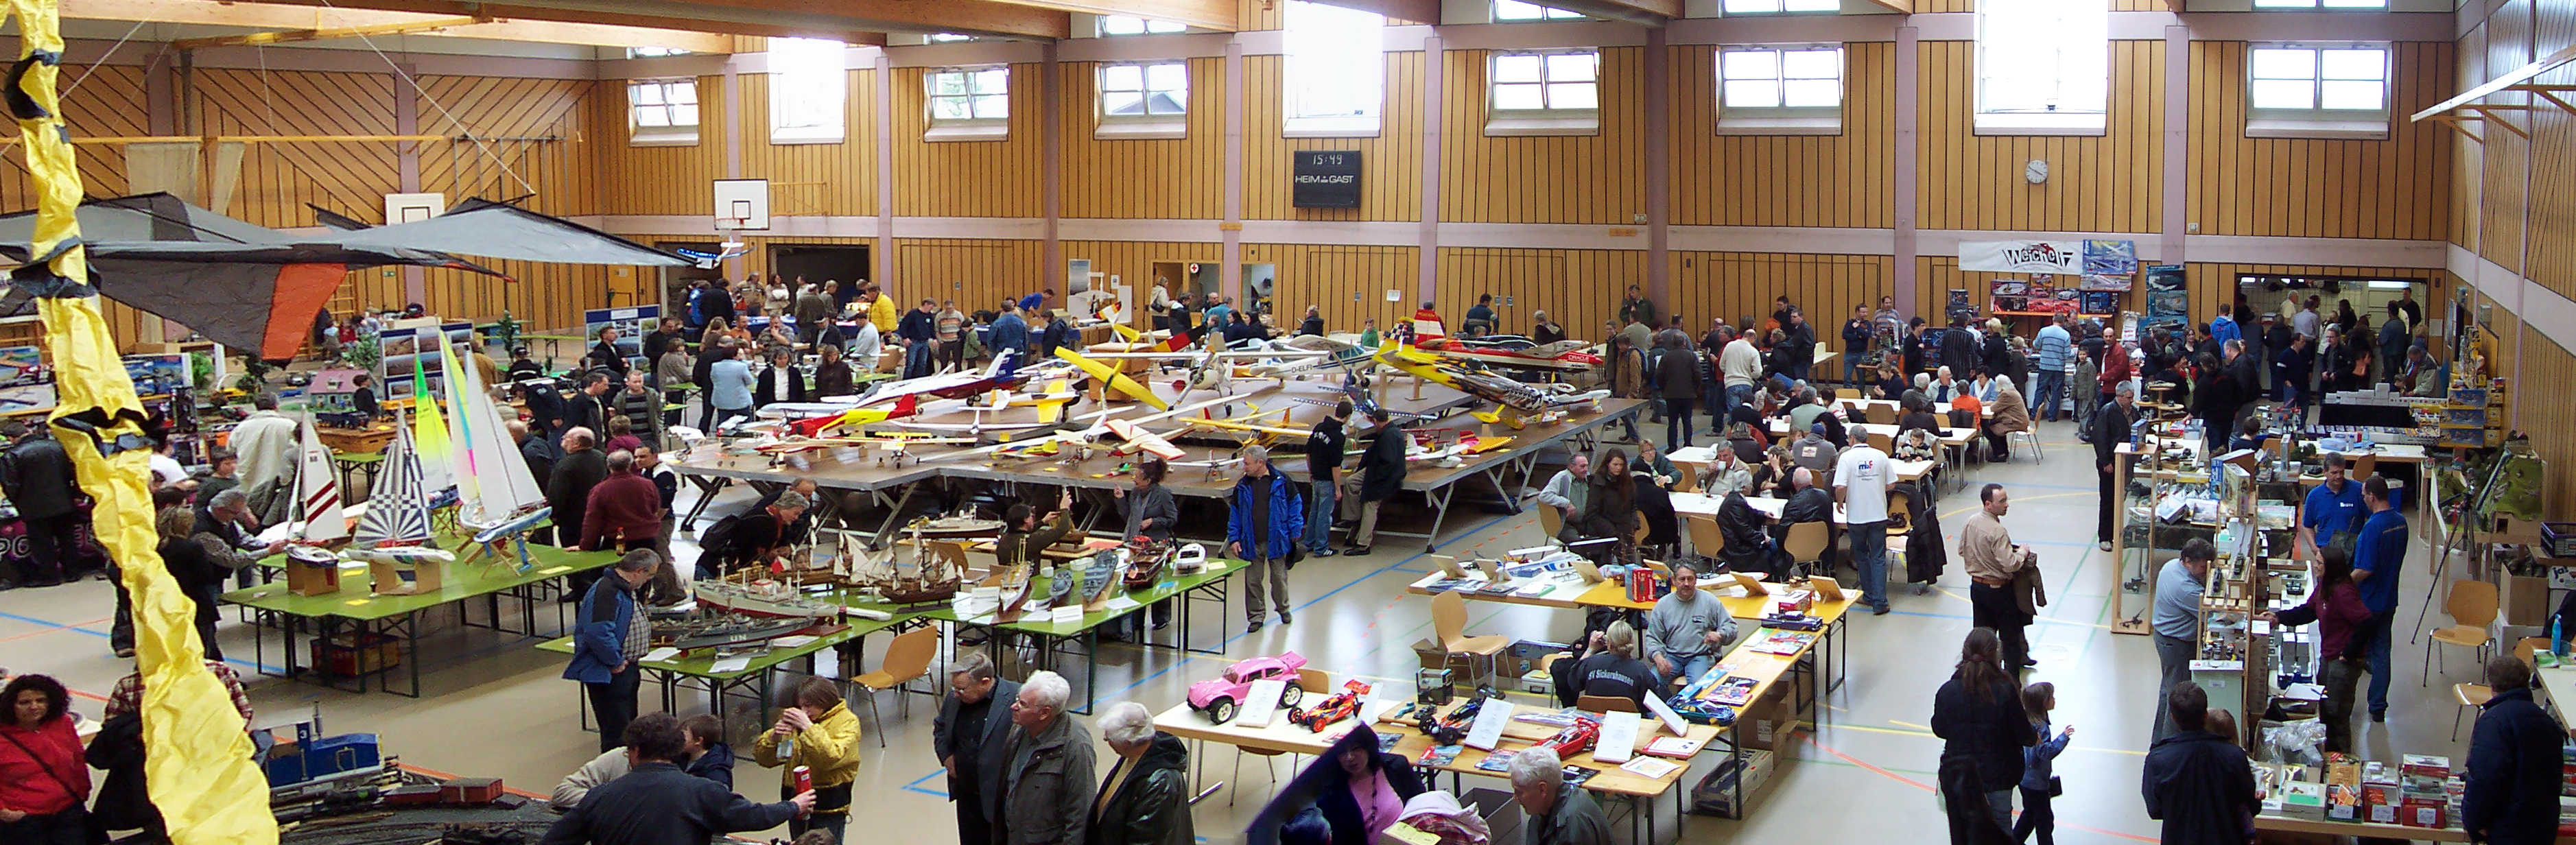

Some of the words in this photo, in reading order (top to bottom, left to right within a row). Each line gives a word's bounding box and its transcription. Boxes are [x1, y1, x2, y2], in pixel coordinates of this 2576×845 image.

[1313, 154, 1343, 165] 15:49
[1295, 175, 1321, 183] HEIM
[1329, 175, 1354, 183] GAST
[730, 633, 747, 642] UN
[299, 730, 307, 739] 3
